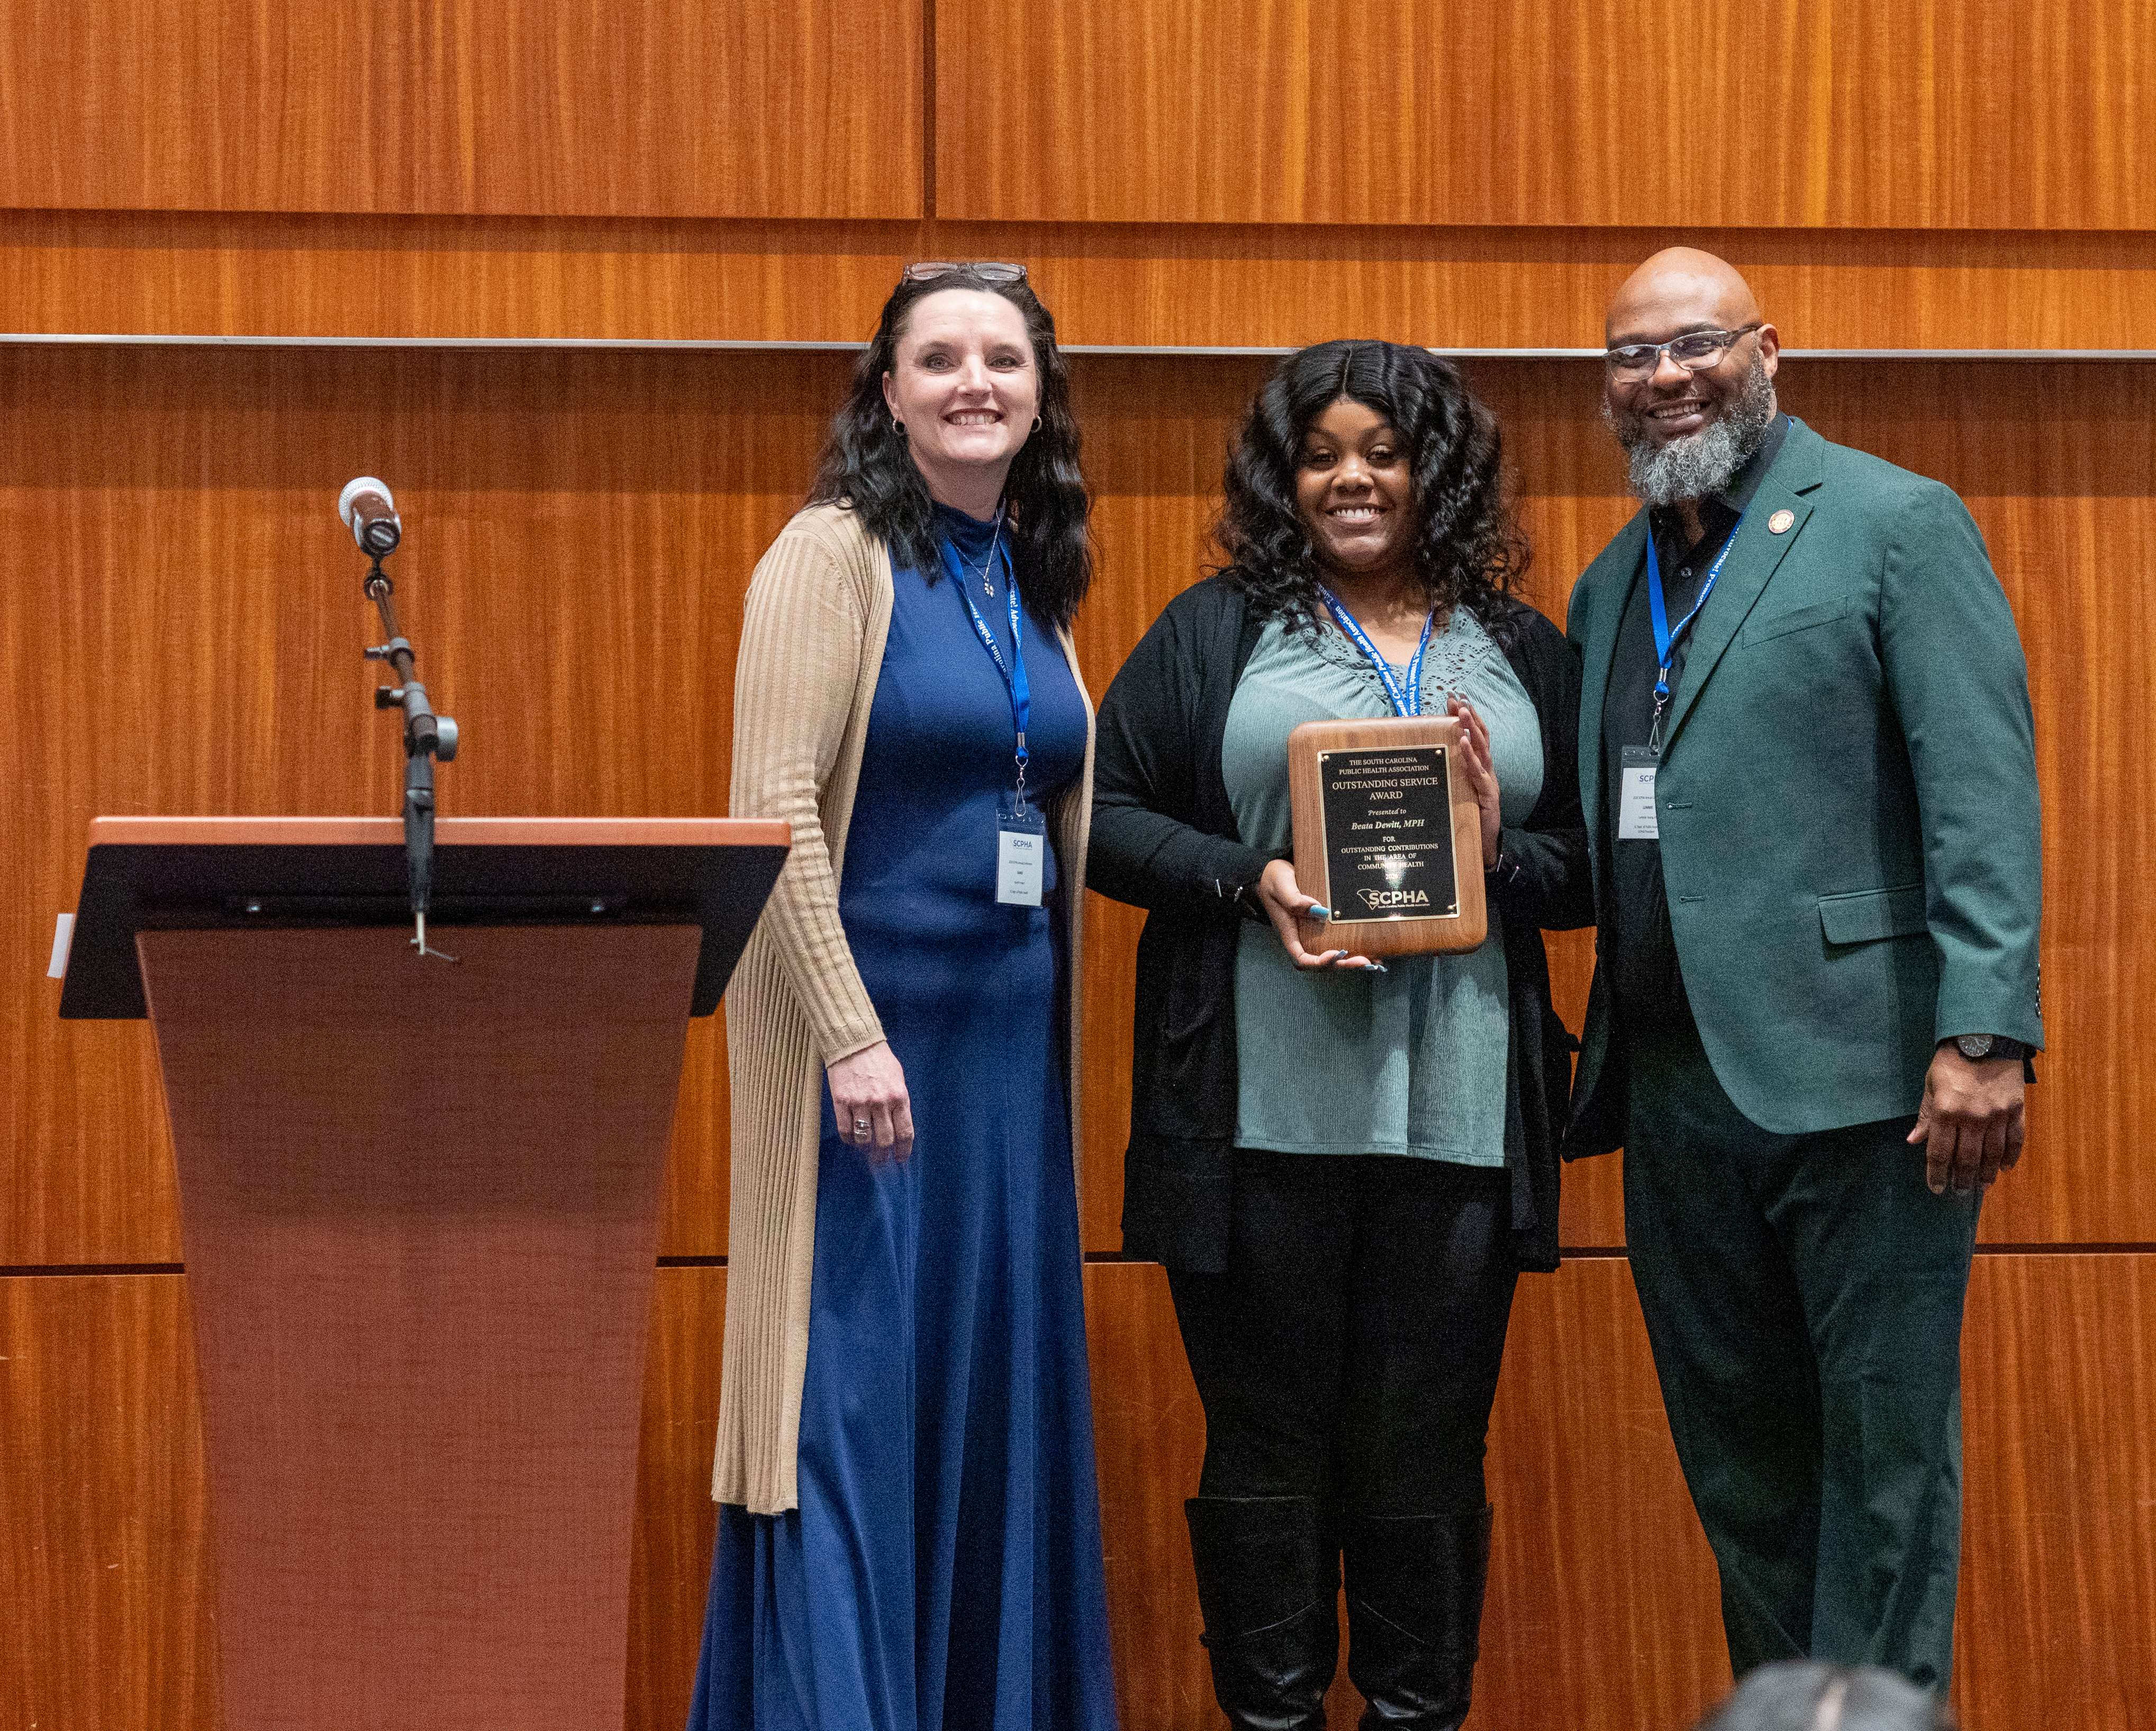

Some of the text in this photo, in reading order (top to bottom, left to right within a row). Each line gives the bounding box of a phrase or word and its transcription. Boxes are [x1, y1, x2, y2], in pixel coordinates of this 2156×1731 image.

[1335, 605, 1362, 637] Association
[977, 620, 994, 646] Public
[1356, 637, 1375, 654] Health
[1371, 651, 1387, 672] Public
[1383, 671, 1401, 699] Carolina
[1332, 777, 1438, 790] OUTSTANDING SERVICE
[1370, 791, 1403, 800] AWARD
[1403, 819, 1425, 828] MPH
[1013, 839, 1032, 848] SCPHA
[1388, 843, 1438, 851] CONTRIBUTIONS
[1369, 890, 1429, 905] SCPHA
